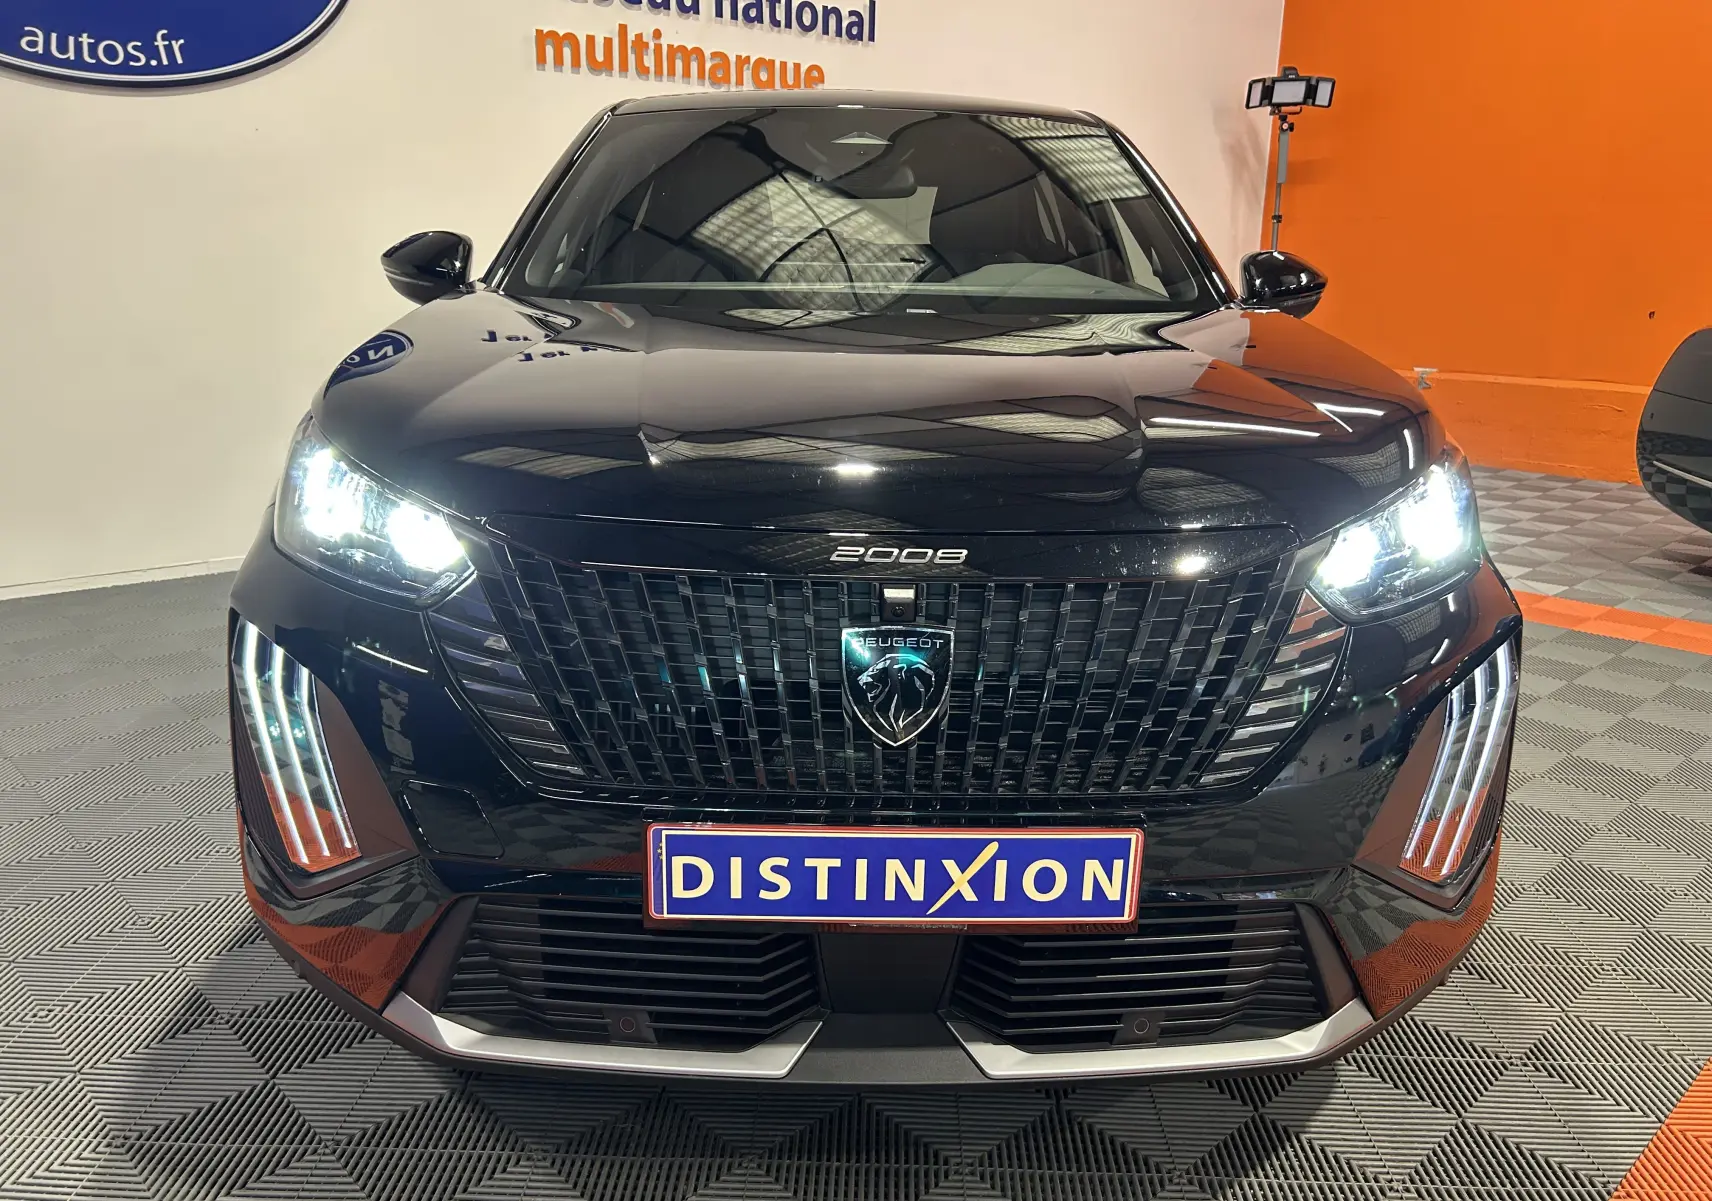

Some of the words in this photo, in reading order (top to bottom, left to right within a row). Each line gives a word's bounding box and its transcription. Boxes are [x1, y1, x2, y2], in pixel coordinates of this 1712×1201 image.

[714, 0, 876, 43] national
[20, 26, 185, 67] autos.fr
[535, 23, 825, 90] multimarque
[829, 546, 968, 564] 2008
[851, 637, 944, 649] PEUGEOT
[671, 841, 1124, 915] DISTINXION
